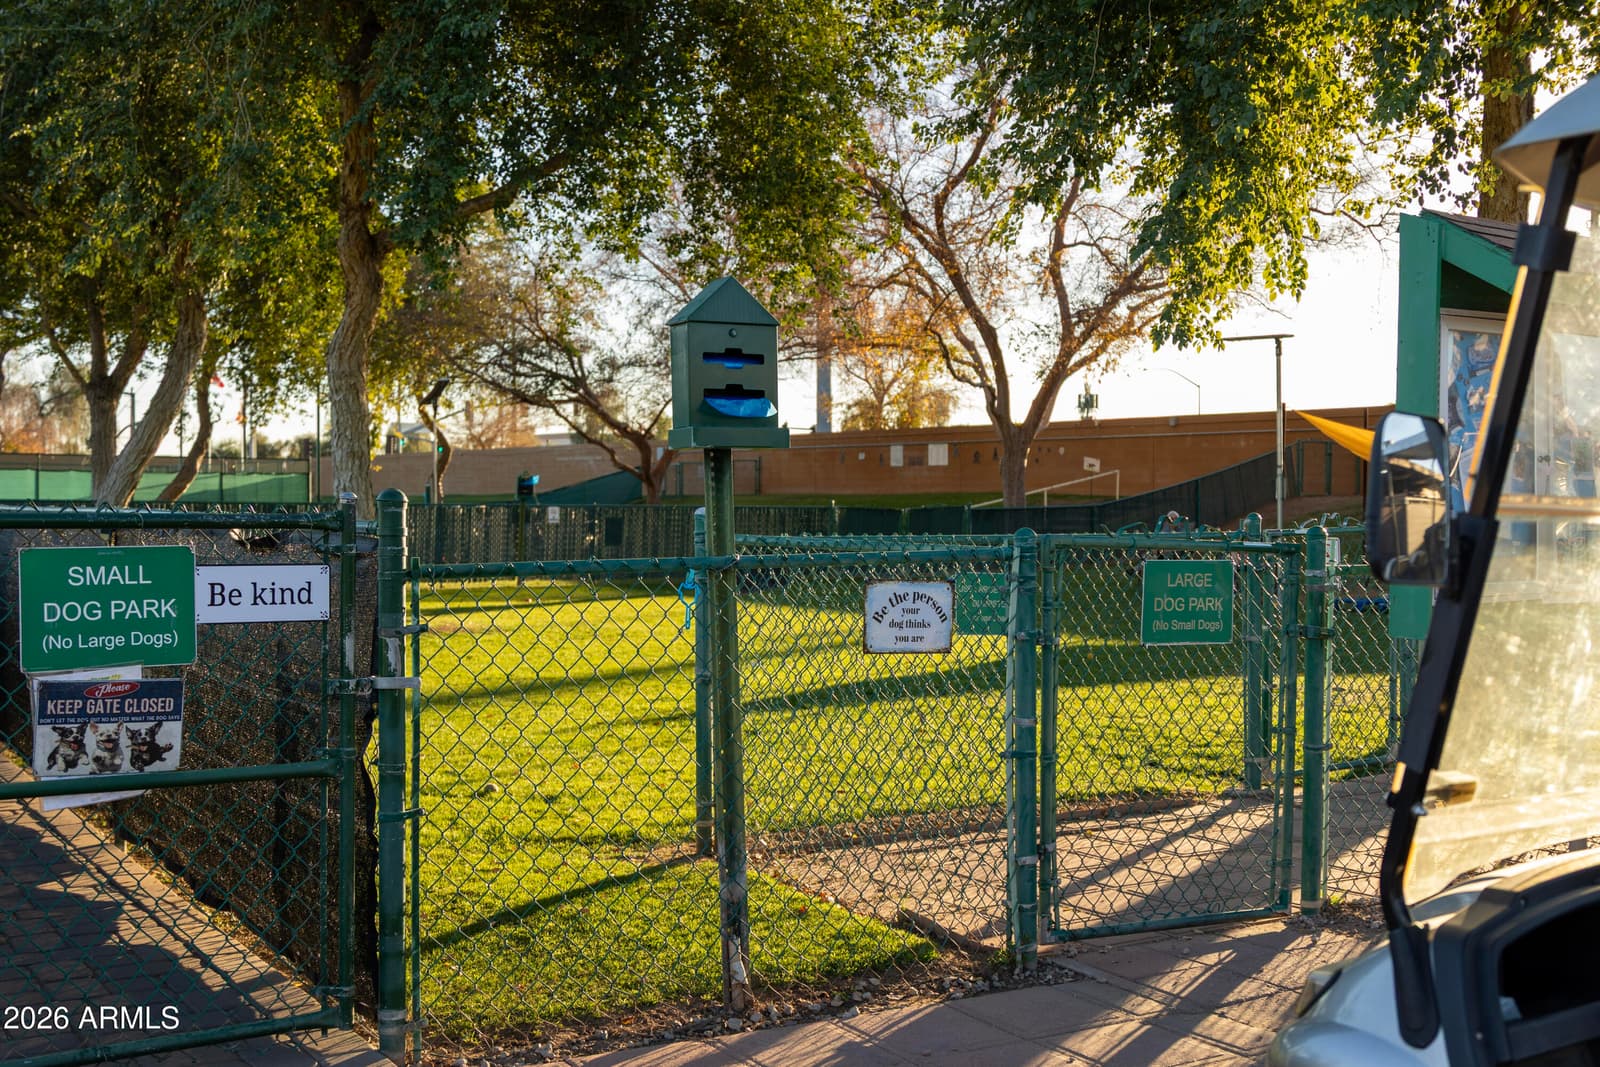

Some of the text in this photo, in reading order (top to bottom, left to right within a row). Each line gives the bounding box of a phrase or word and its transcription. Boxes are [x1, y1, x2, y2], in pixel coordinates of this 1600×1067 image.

[67, 564, 152, 586] SMALL
[1167, 573, 1213, 588] LARGE
[207, 581, 314, 607] Be kind
[43, 598, 177, 622] DOG PARK
[872, 591, 948, 624] Be the person
[901, 607, 921, 617] your
[1153, 597, 1224, 612] DOG PARK
[888, 619, 931, 631] dog thinks
[1152, 619, 1224, 632] (No Small Dogs)
[42, 629, 178, 653] (No Large Dogs)
[894, 635, 925, 645] you are
[95, 682, 131, 697] Please
[47, 697, 174, 715] KEEP GATE CLOSED
